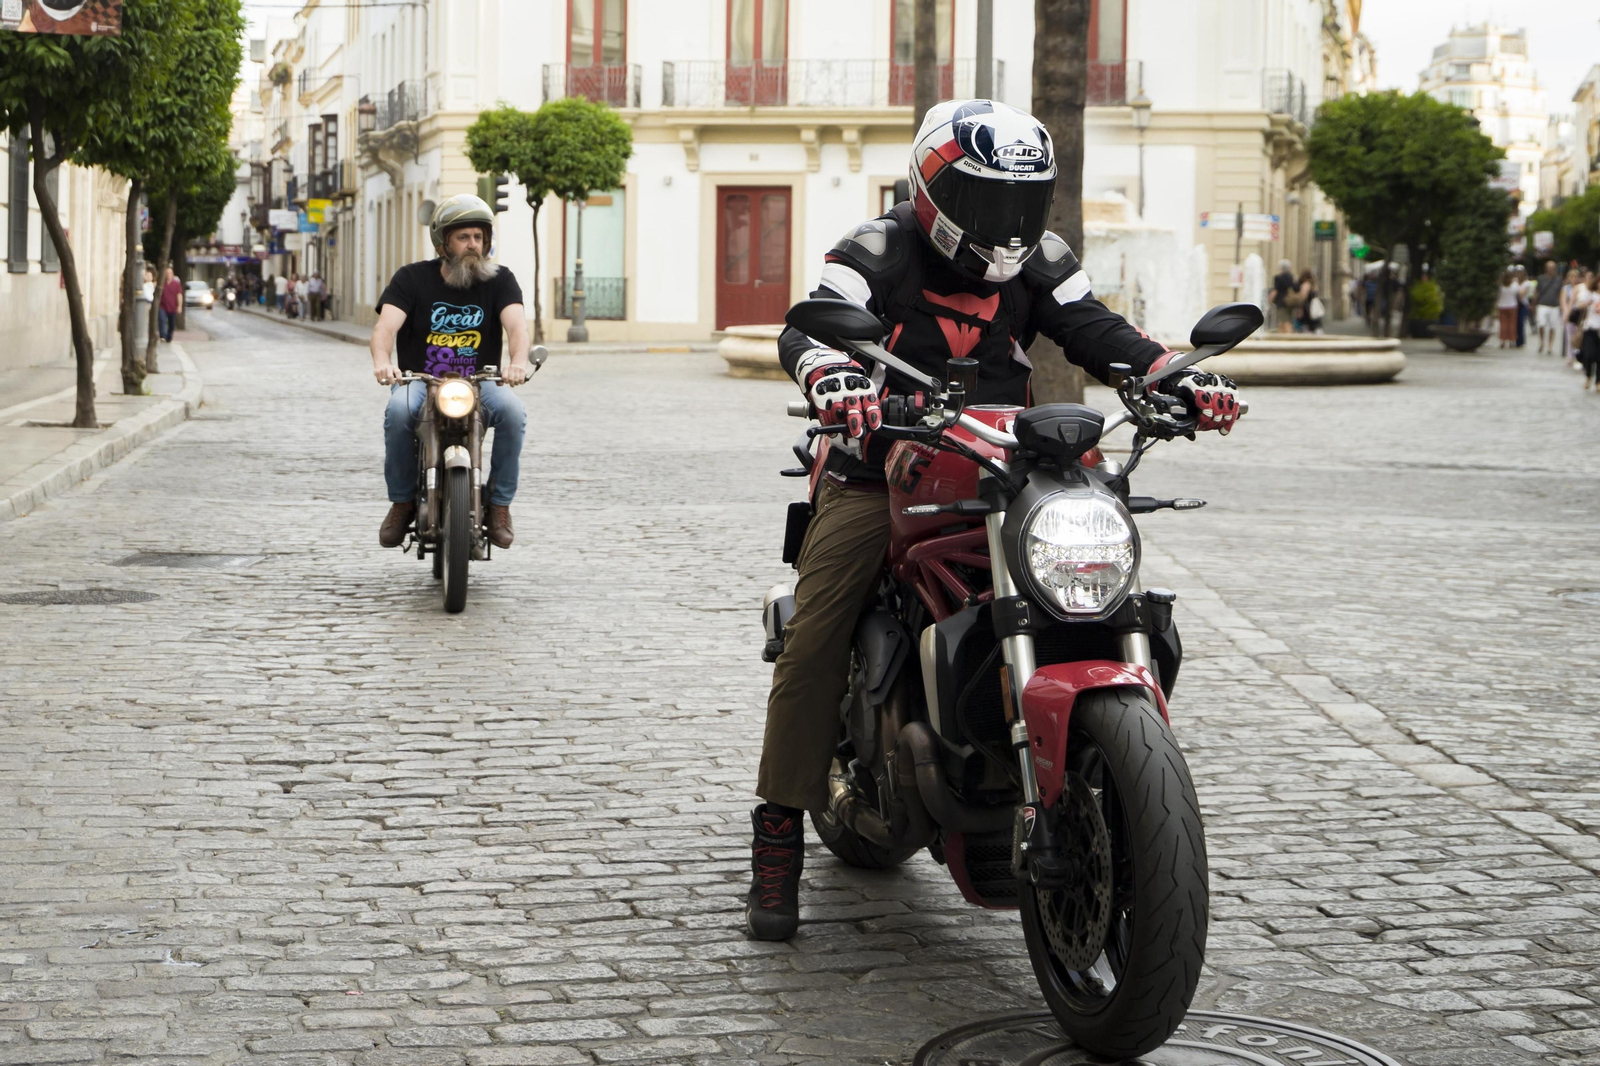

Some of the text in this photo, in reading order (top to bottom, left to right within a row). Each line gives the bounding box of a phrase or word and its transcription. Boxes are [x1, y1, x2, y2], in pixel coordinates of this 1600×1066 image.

[1002, 148, 1037, 158] HJC
[963, 160, 982, 173] RPHA
[1008, 164, 1035, 172] DUCATI
[933, 235, 950, 252] DUCATI
[431, 302, 484, 331] Great
[426, 330, 482, 349] never
[426, 345, 477, 365] comfort
[758, 834, 782, 843] DUCATI
